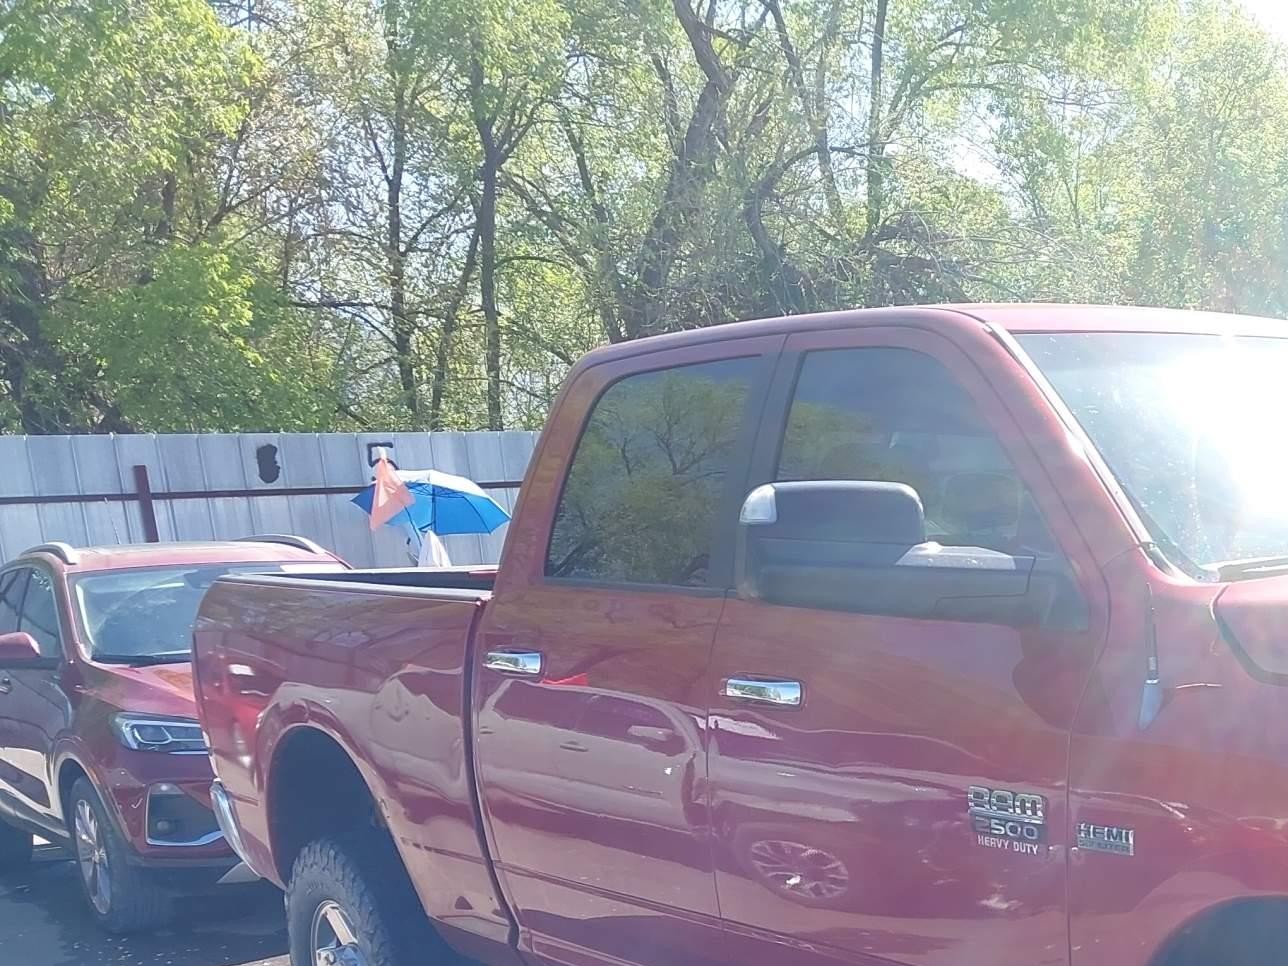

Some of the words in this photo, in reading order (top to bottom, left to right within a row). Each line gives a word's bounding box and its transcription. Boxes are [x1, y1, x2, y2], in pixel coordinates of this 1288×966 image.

[967, 785, 1044, 817] RAM
[974, 816, 1039, 841] 2500
[1079, 822, 1134, 845] HEMI
[976, 834, 1009, 849] HEAVY
[1013, 841, 1039, 856] DUTY
